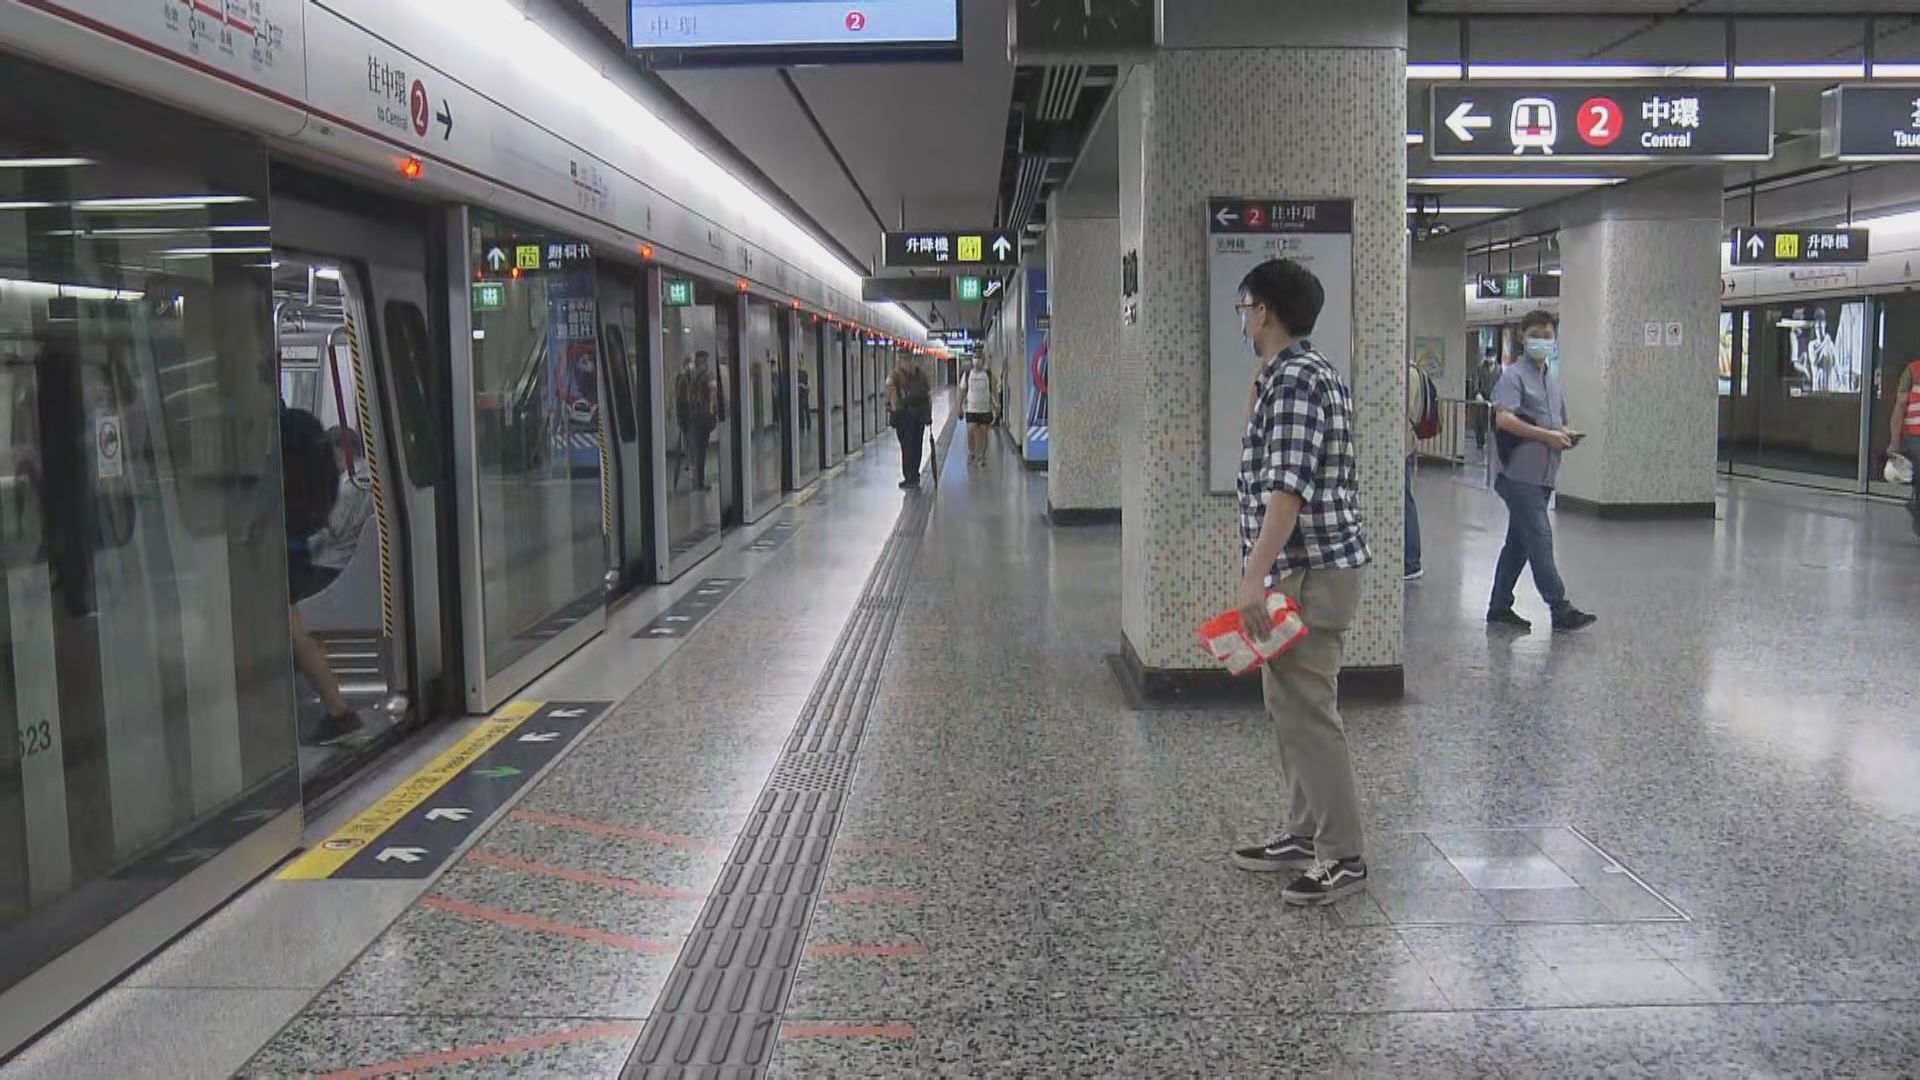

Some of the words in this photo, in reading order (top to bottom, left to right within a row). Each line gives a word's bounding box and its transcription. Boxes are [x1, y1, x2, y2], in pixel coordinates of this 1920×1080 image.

[850, 14, 861, 29] 2
[367, 55, 407, 106] 往中環
[415, 90, 425, 127] 2
[1642, 96, 1699, 128] 中環
[1589, 106, 1609, 137] 2
[1641, 131, 1691, 148] Central
[1249, 208, 1260, 224] 2
[905, 235, 949, 254] 升降機
[1806, 233, 1849, 250] 升降機
